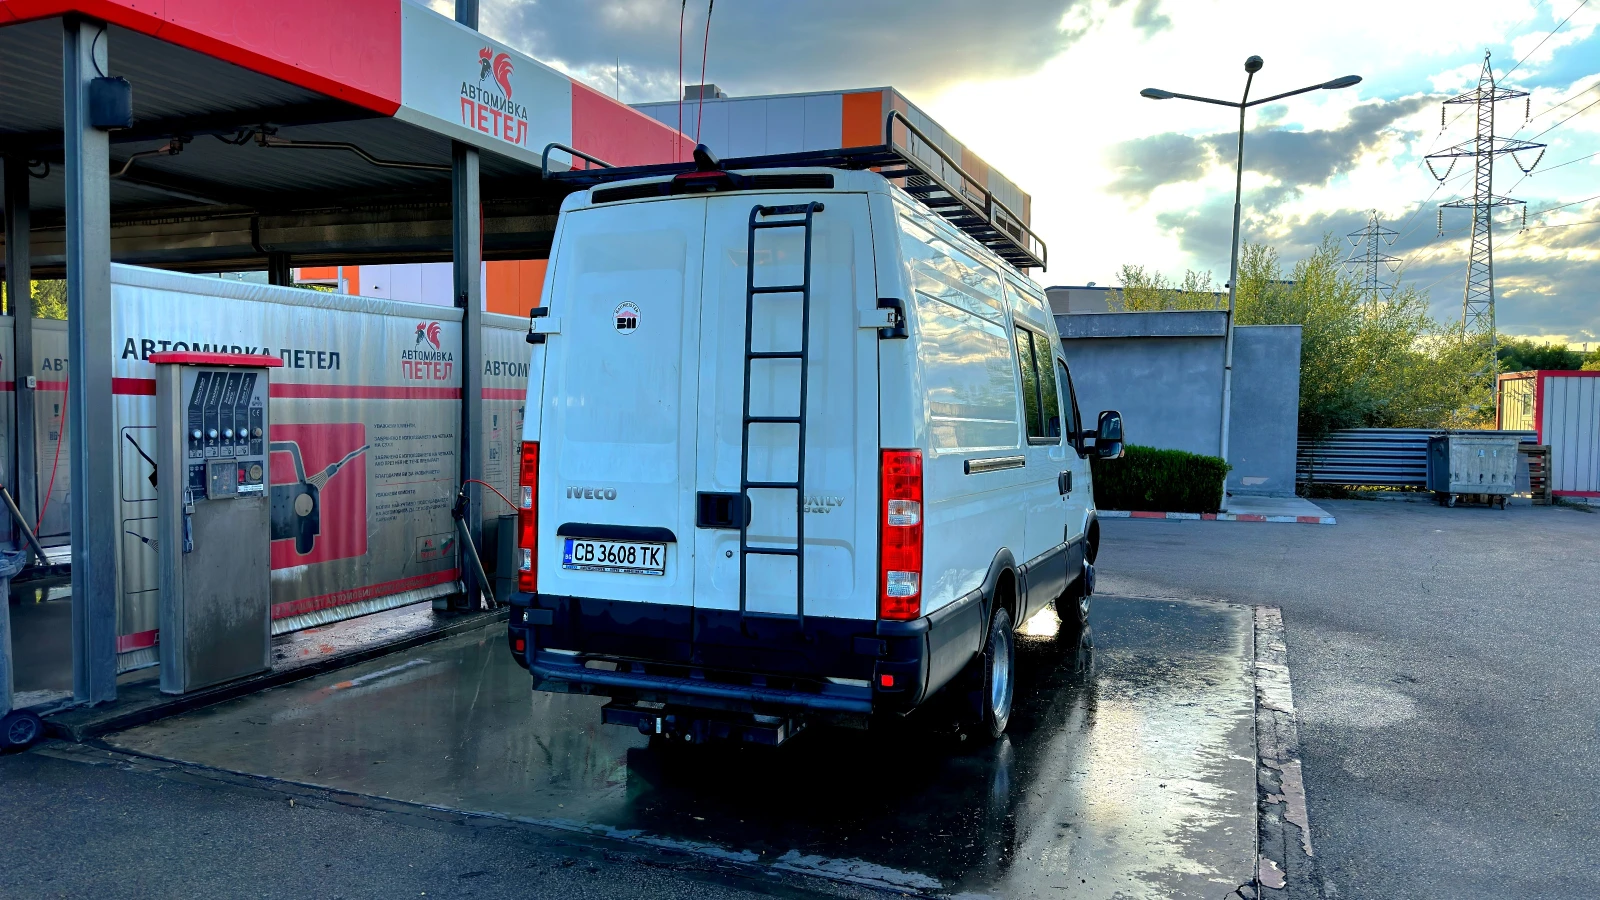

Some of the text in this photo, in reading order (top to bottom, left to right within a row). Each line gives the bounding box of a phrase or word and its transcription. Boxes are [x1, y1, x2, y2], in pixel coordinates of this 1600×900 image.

[461, 81, 528, 120] АВТОМИВКА
[460, 96, 528, 147] ПЕТЕЛ
[279, 348, 341, 370] ПЕТЕЛ
[401, 349, 454, 361] АВТОМИВКА
[401, 361, 453, 380] ПЕТЕЛ
[484, 360, 530, 377] АВТОМ
[566, 486, 617, 500] IVECO
[597, 544, 636, 564] 3608
